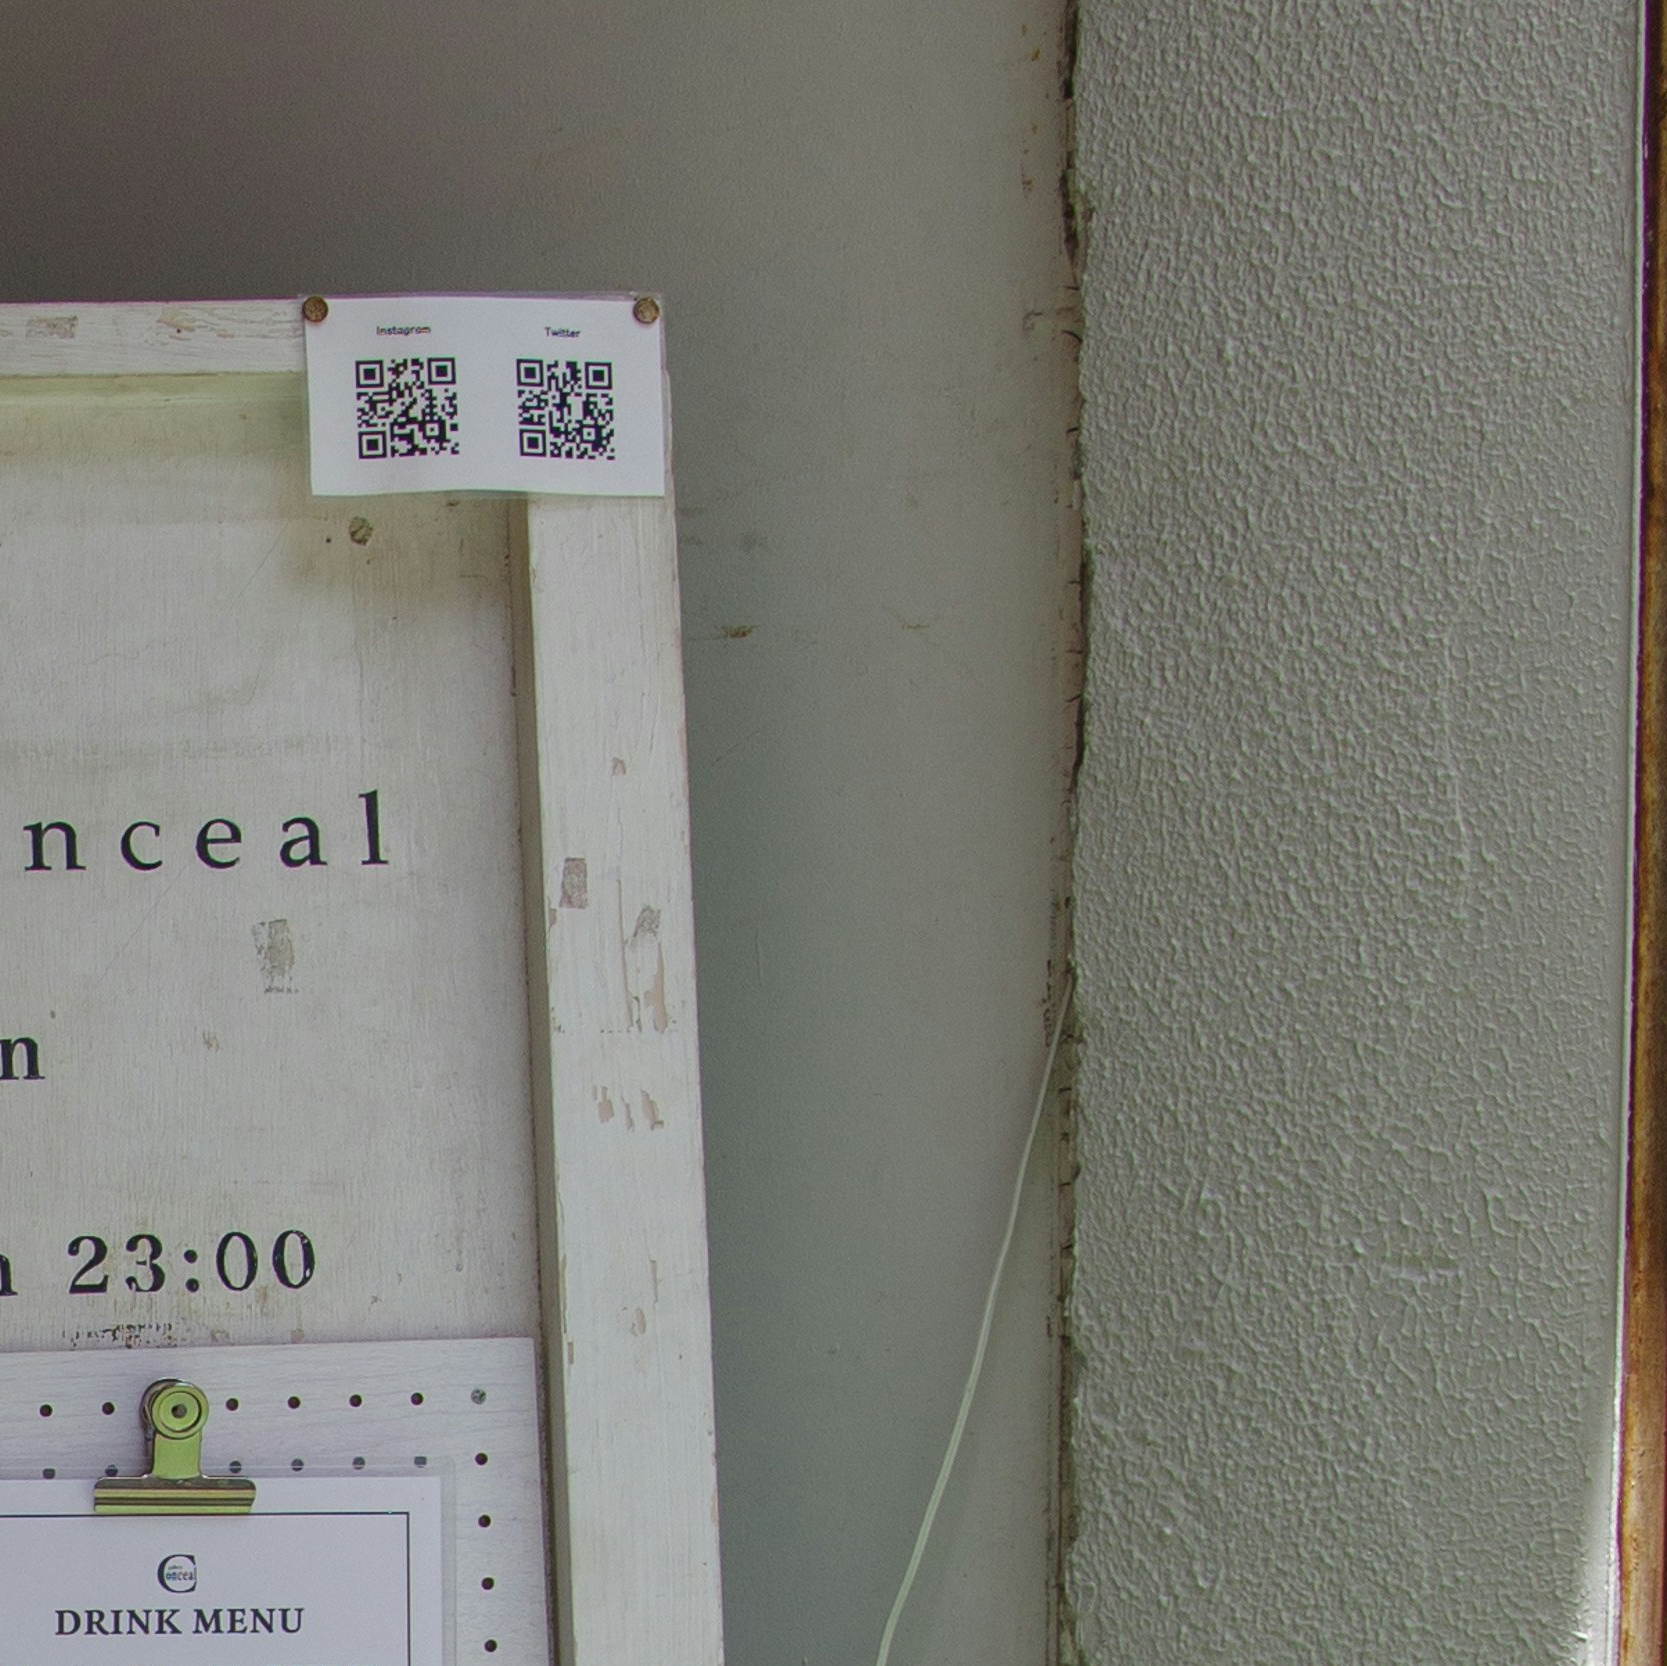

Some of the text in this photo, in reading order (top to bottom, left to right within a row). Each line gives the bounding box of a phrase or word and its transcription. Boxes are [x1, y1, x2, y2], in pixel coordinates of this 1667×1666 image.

[376, 325, 431, 336] Instagram
[545, 327, 581, 338] Twitter
[68, 1229, 318, 1296] 23:00
[55, 1608, 305, 1636] DRINK MENU
